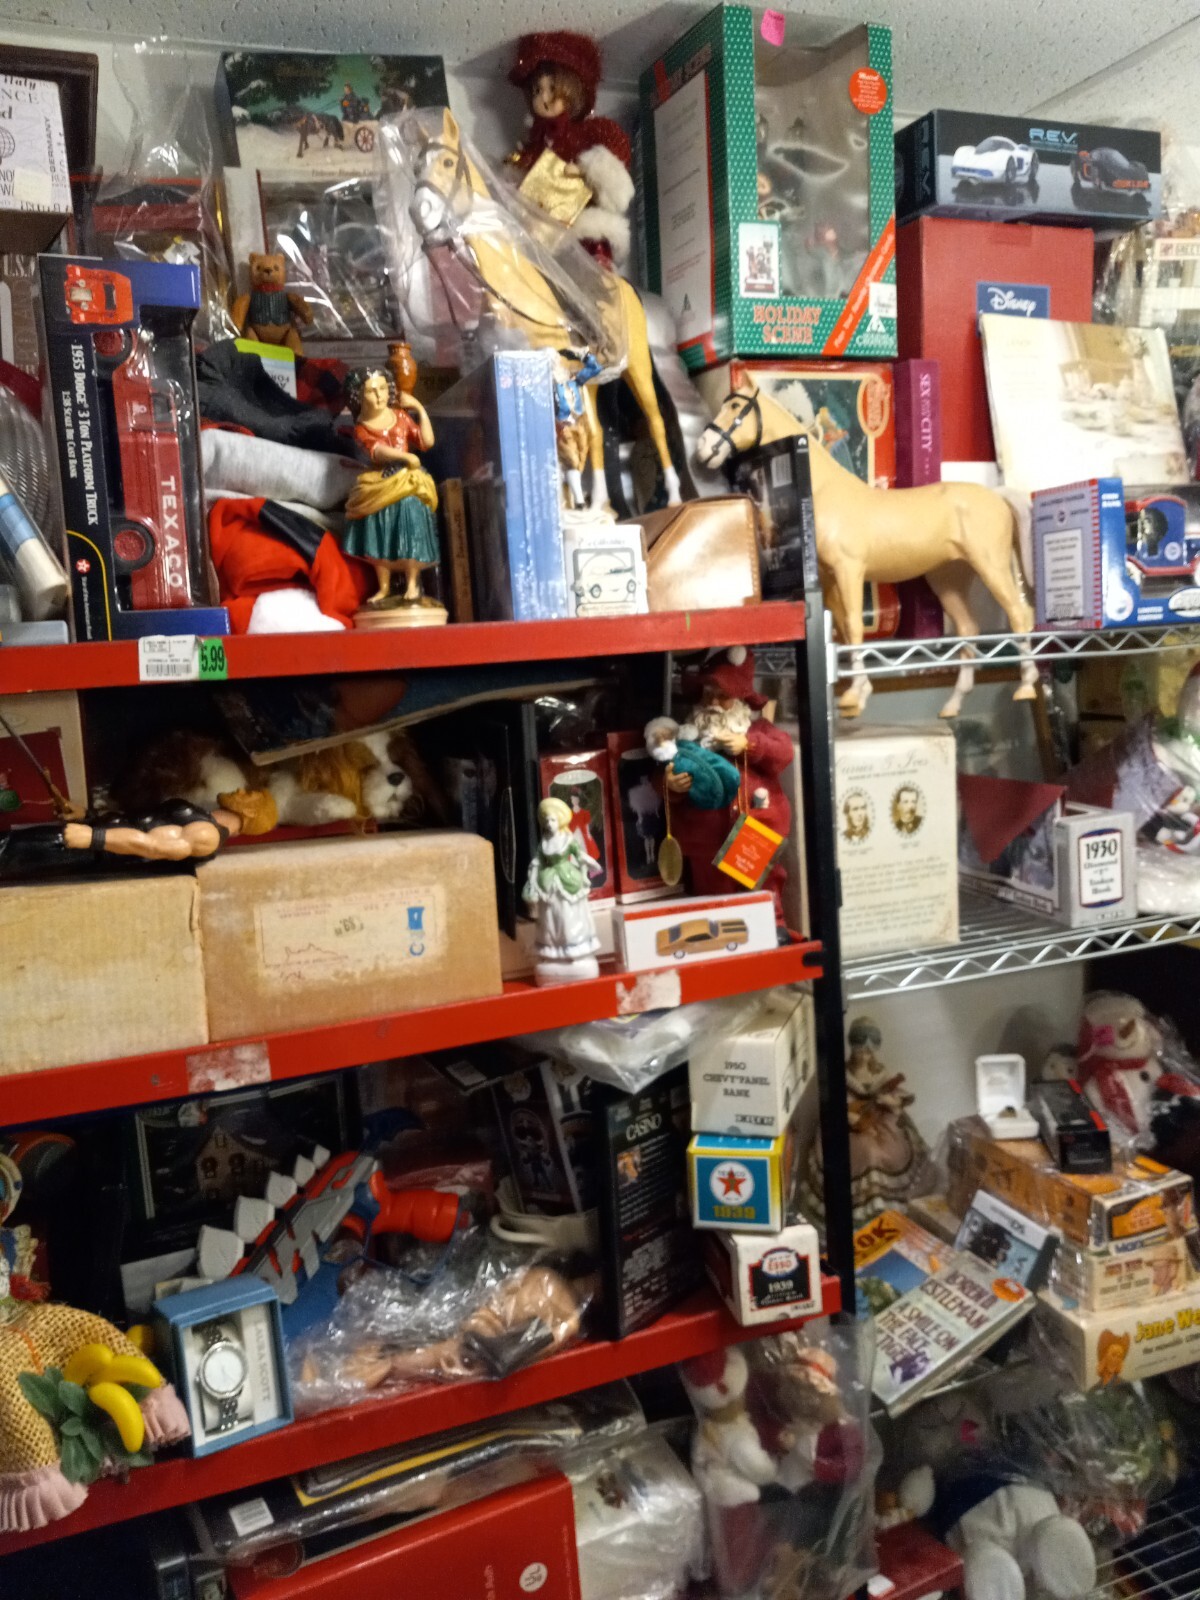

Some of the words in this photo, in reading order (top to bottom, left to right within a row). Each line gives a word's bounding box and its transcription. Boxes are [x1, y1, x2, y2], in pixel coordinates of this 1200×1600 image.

[754, 305, 822, 325] HOLIDAY
[987, 286, 1037, 317] Disney
[762, 325, 813, 345] SCENE
[71, 343, 84, 369] 1935
[78, 410, 89, 418] 3
[919, 373, 931, 396] SEX
[920, 417, 933, 454] CITY
[160, 475, 184, 588] TEXACO
[201, 645, 226, 672] 5.99
[1085, 838, 1118, 859] 1930
[722, 1088, 751, 1098] BANK
[625, 1112, 663, 1142] CASINO
[919, 1278, 990, 1330] ESTLEMAN
[878, 1310, 907, 1334] THE
[900, 1326, 931, 1352] FACE
[905, 1306, 940, 1337] SMILE
[934, 1329, 961, 1352] ON
[1135, 1318, 1176, 1343] Jane
